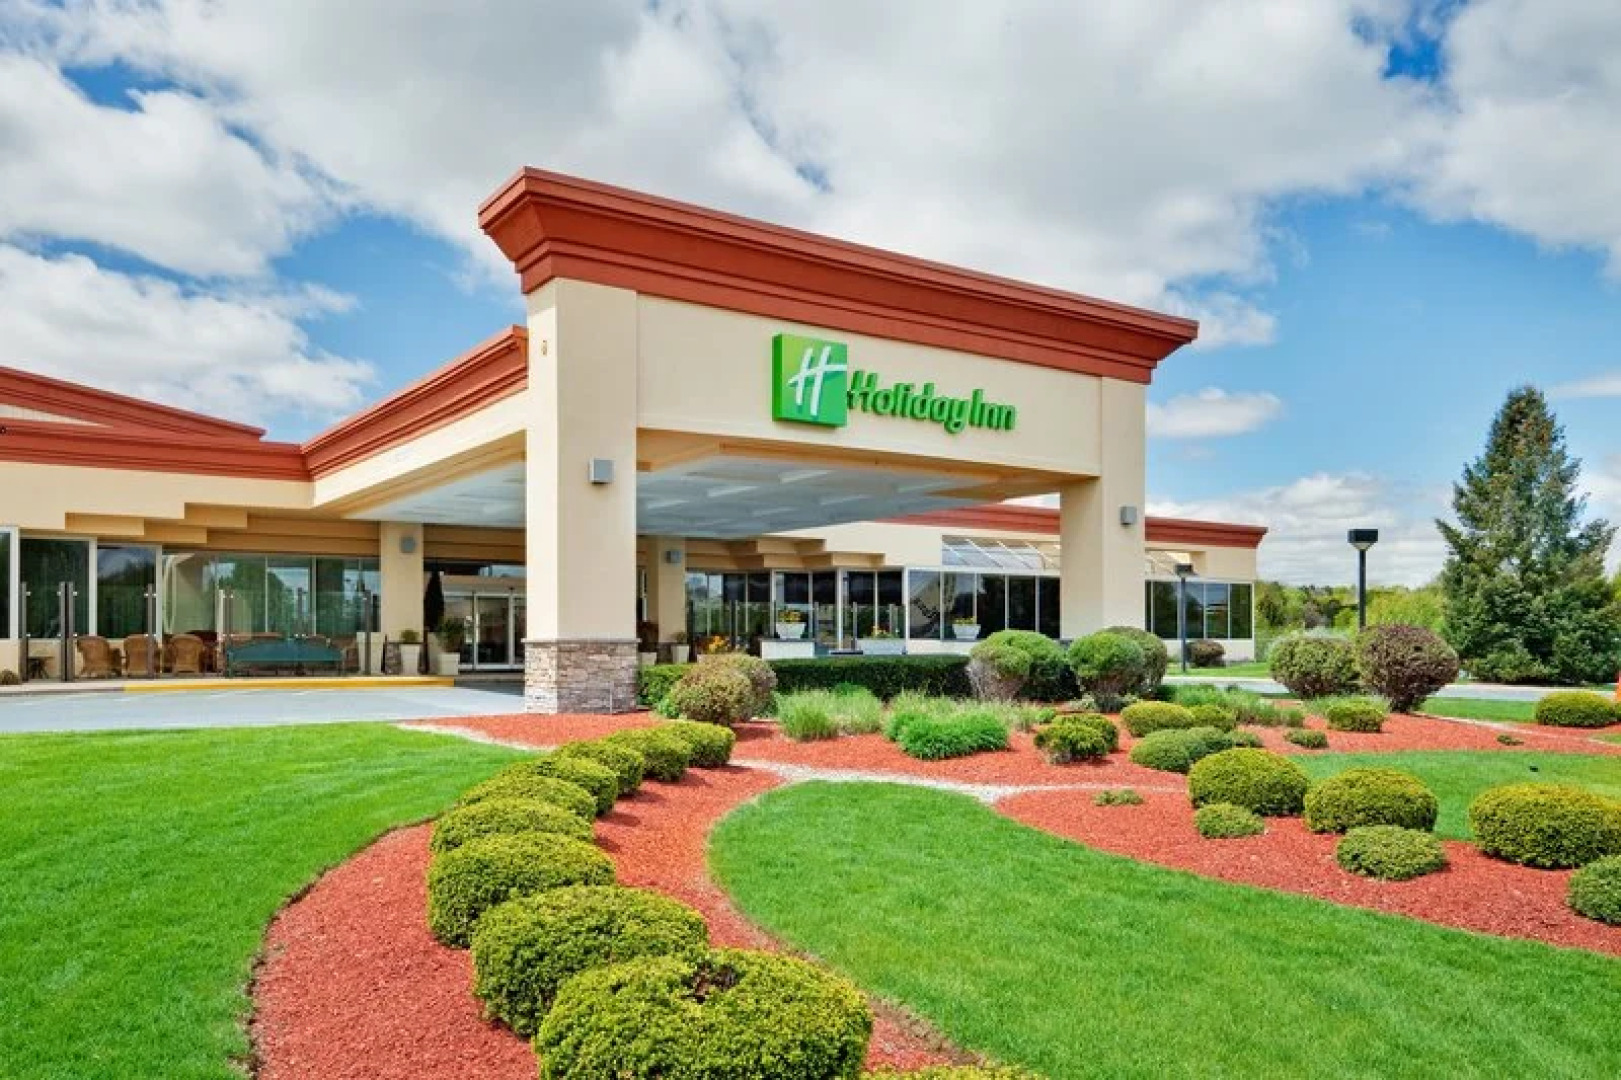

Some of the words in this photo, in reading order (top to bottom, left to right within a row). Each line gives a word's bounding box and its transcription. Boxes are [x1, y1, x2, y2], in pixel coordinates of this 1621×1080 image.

[788, 346, 847, 417] H
[847, 370, 967, 434] Holiday
[968, 388, 1016, 430] Inn
